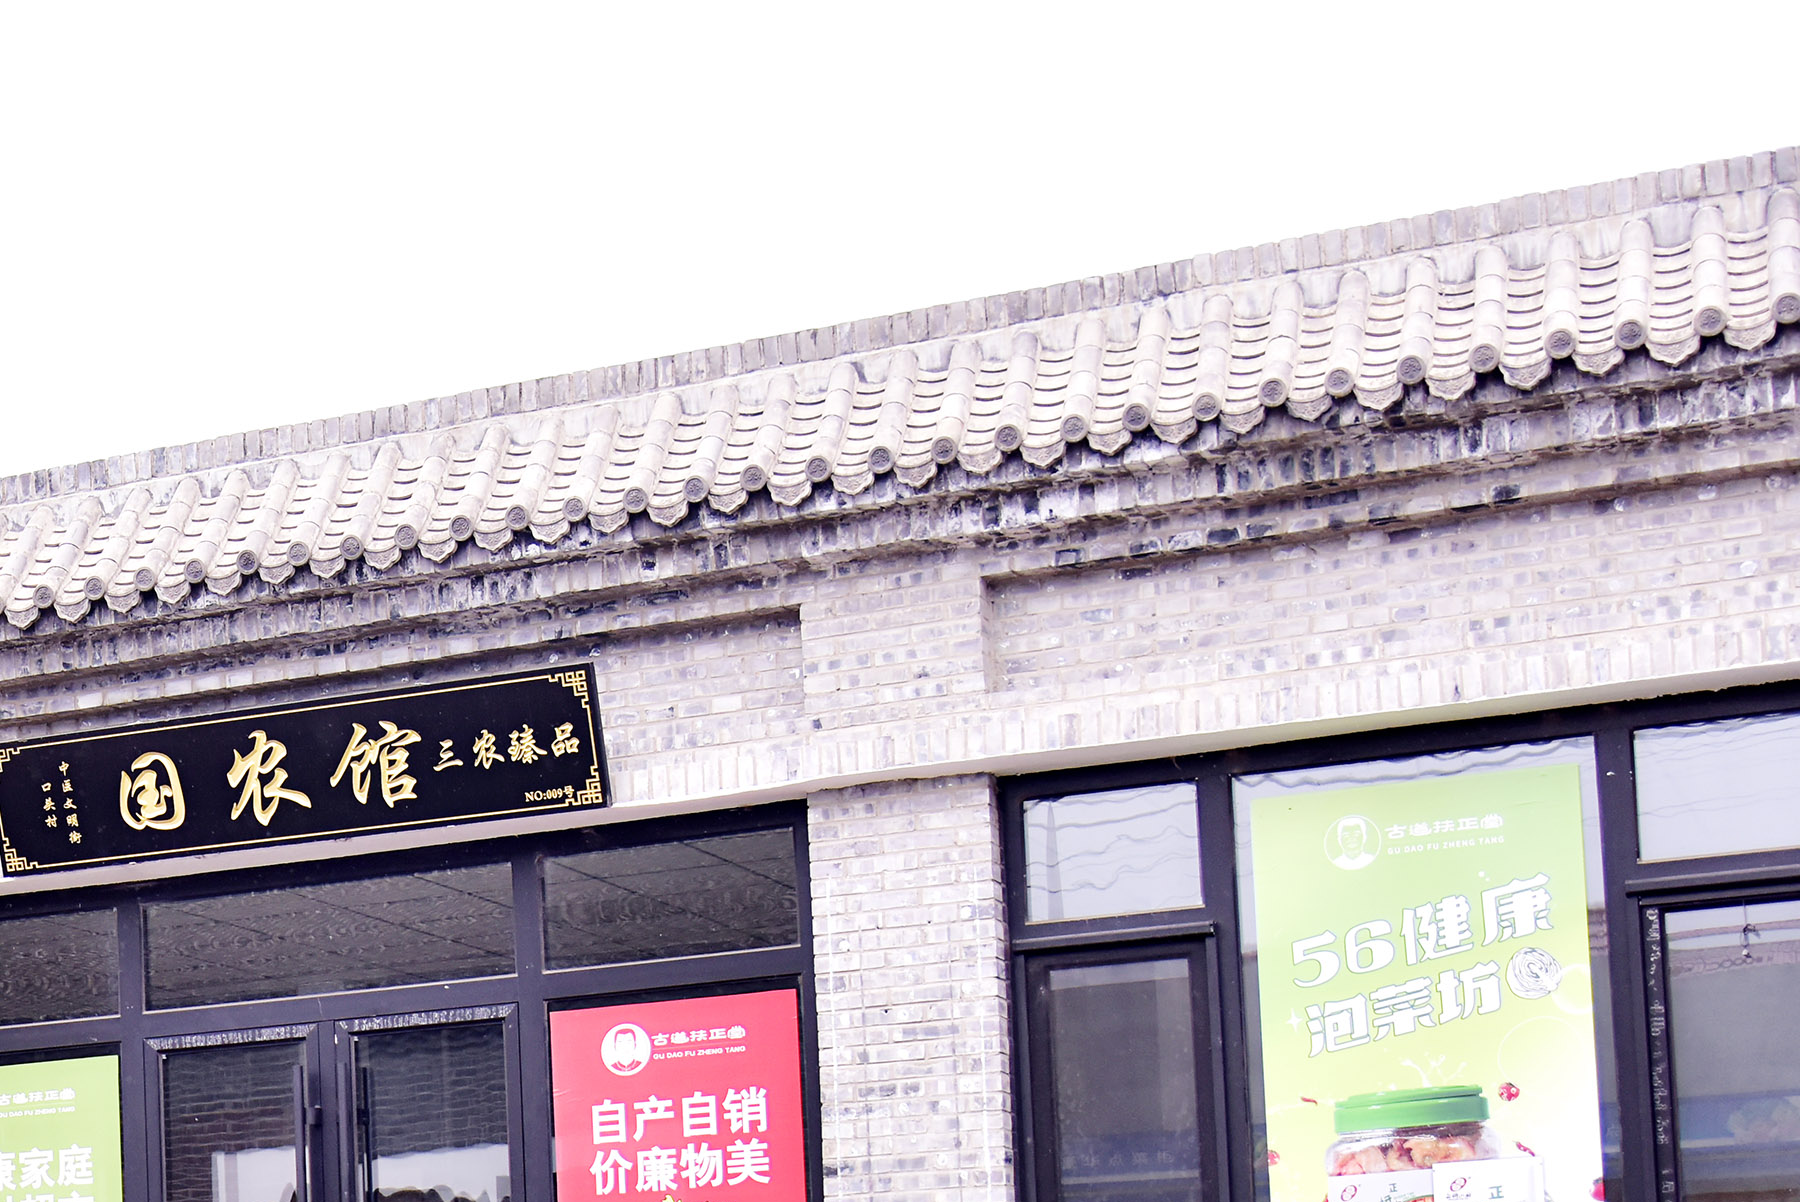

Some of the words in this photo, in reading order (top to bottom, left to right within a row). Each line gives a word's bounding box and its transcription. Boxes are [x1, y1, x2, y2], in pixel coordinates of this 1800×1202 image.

[119, 720, 422, 831] 国农馆
[432, 722, 580, 772] 三农臻品
[41, 782, 58, 828] 口头村
[58, 760, 82, 844] 中医文明街
[524, 785, 575, 802] NO:009号
[1404, 844, 1424, 853] DAO
[1427, 842, 1439, 850] FU
[1442, 838, 1476, 849] ZHENG
[1478, 835, 1505, 845] TANG
[1290, 871, 1555, 988] 56健康
[1304, 959, 1503, 1059] 泡菜坊
[666, 1051, 683, 1059] DAO
[591, 1086, 768, 1145] 自产自销
[589, 1138, 771, 1195] 价廉物美
